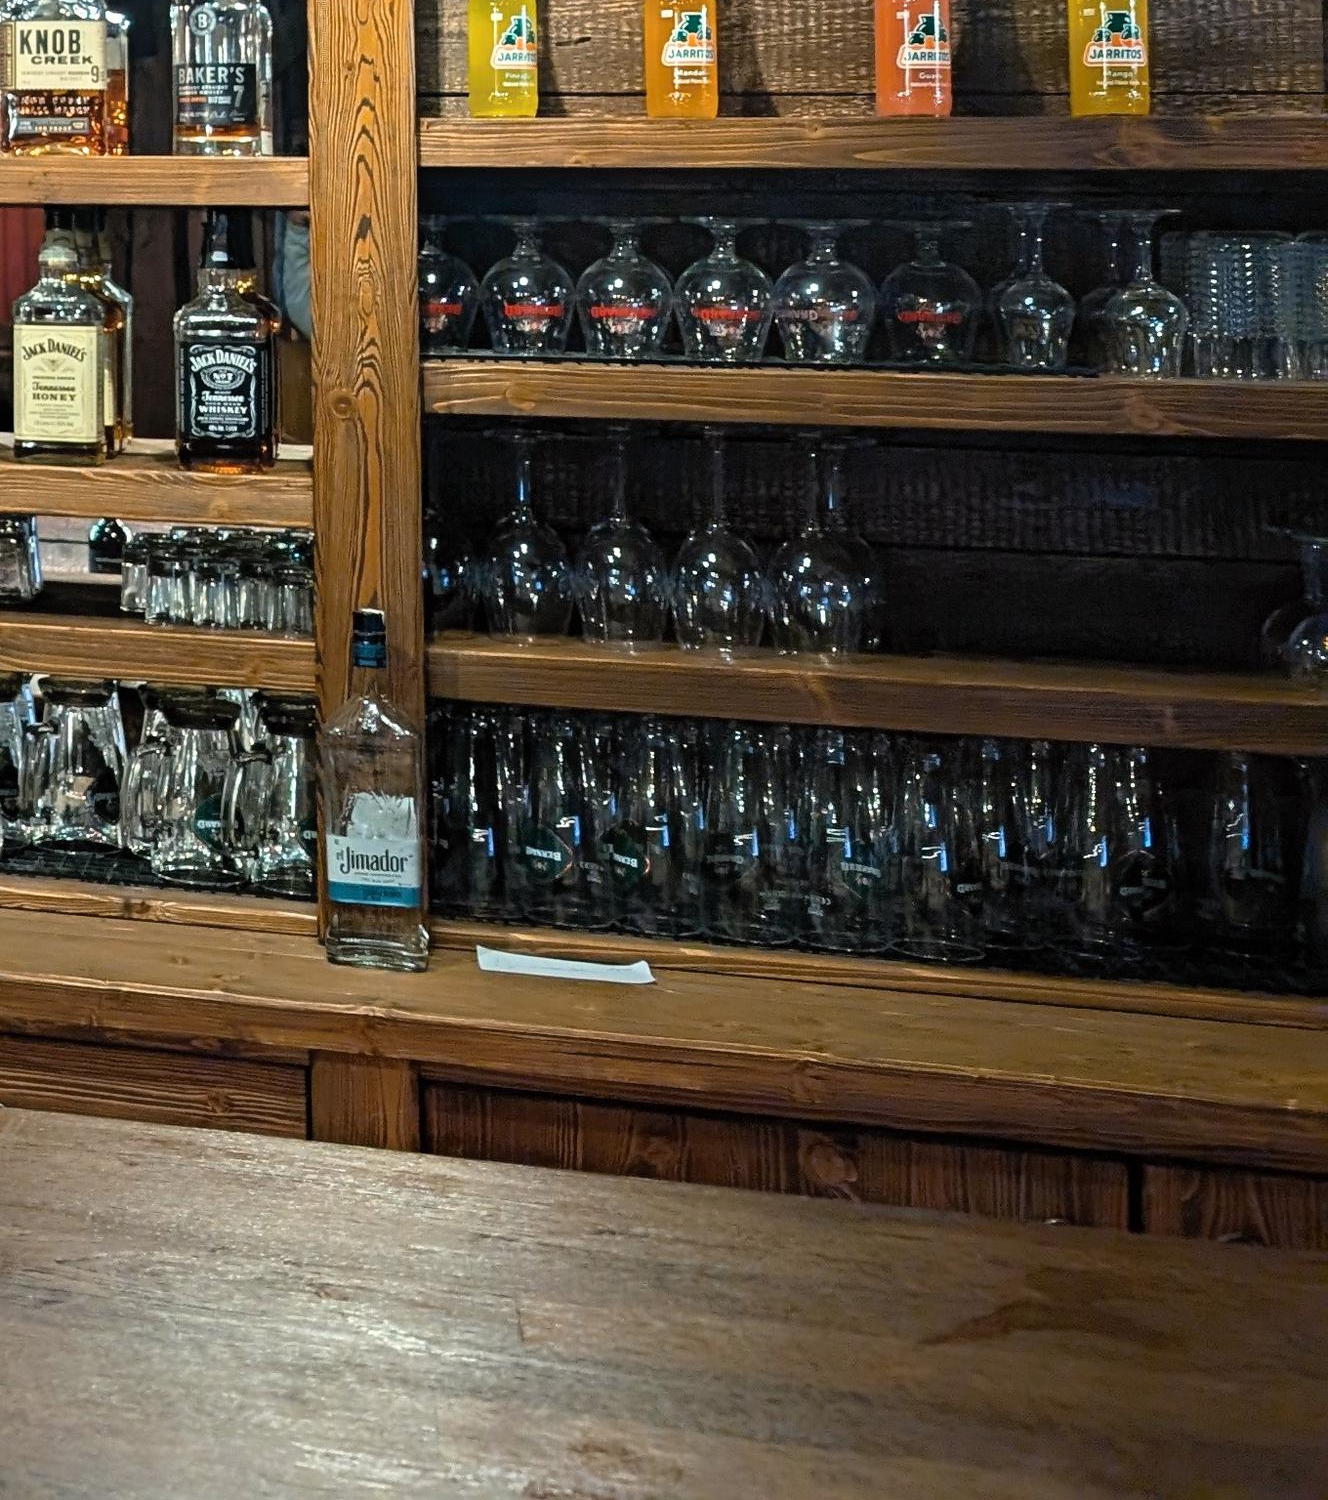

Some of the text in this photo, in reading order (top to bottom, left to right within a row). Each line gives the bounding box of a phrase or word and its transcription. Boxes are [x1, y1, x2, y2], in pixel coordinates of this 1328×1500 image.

[20, 29, 81, 55] KNOB
[31, 55, 93, 65] CREEK
[668, 50, 714, 59] JARRITOS
[1089, 49, 1142, 60] JARRITOS
[90, 65, 100, 84] 9
[178, 66, 245, 84] BAKER'S
[1105, 71, 1133, 79] Mango
[233, 85, 245, 108] 7
[22, 338, 88, 362] JACK DANIEL'S
[189, 349, 258, 375] JACK DANIEL'S
[31, 381, 76, 393] Tennessee
[32, 393, 77, 402] HONEY
[201, 390, 245, 403] Tennessee
[198, 405, 248, 415] WHISKEY
[340, 846, 409, 875] Jimador
